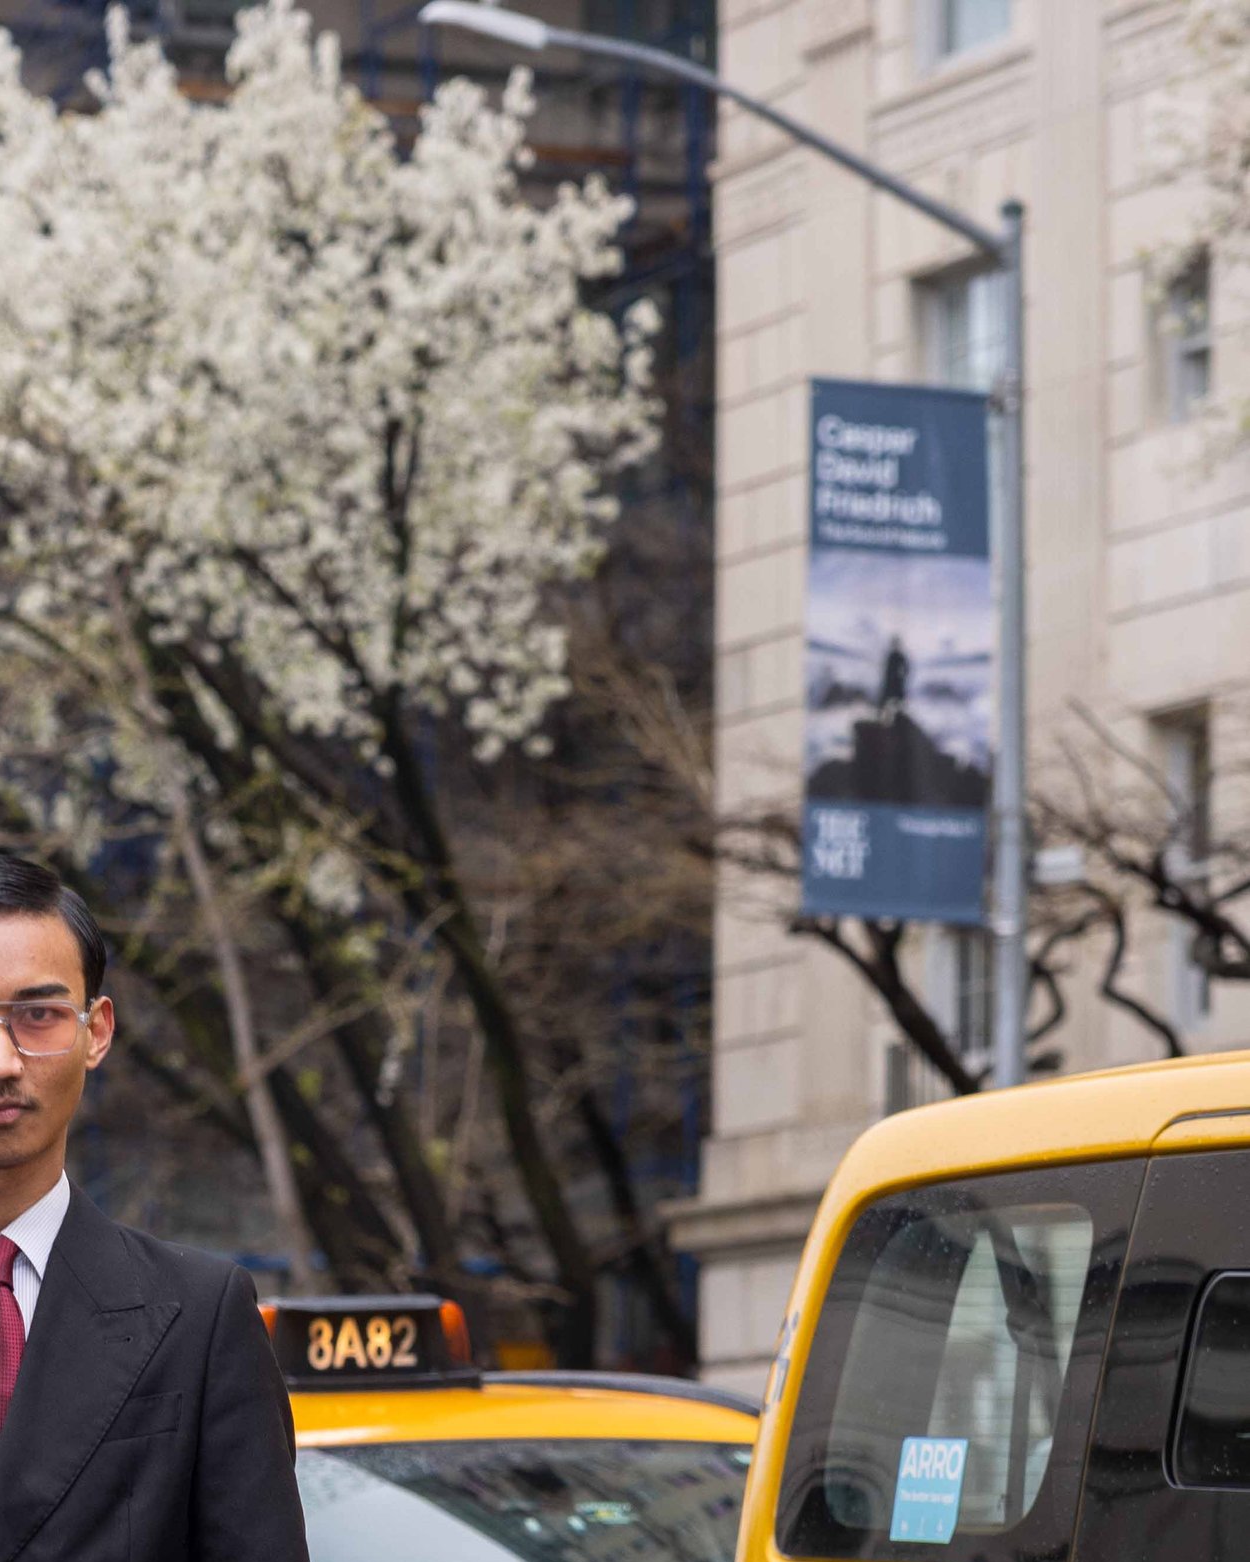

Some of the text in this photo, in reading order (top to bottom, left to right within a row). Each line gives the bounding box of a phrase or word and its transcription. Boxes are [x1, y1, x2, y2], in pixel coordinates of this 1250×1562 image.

[816, 413, 919, 456] Casper
[816, 449, 899, 487] David
[816, 484, 942, 526] Friedrich
[307, 1315, 418, 1372] 8A82
[901, 1442, 963, 1481] ARRO
